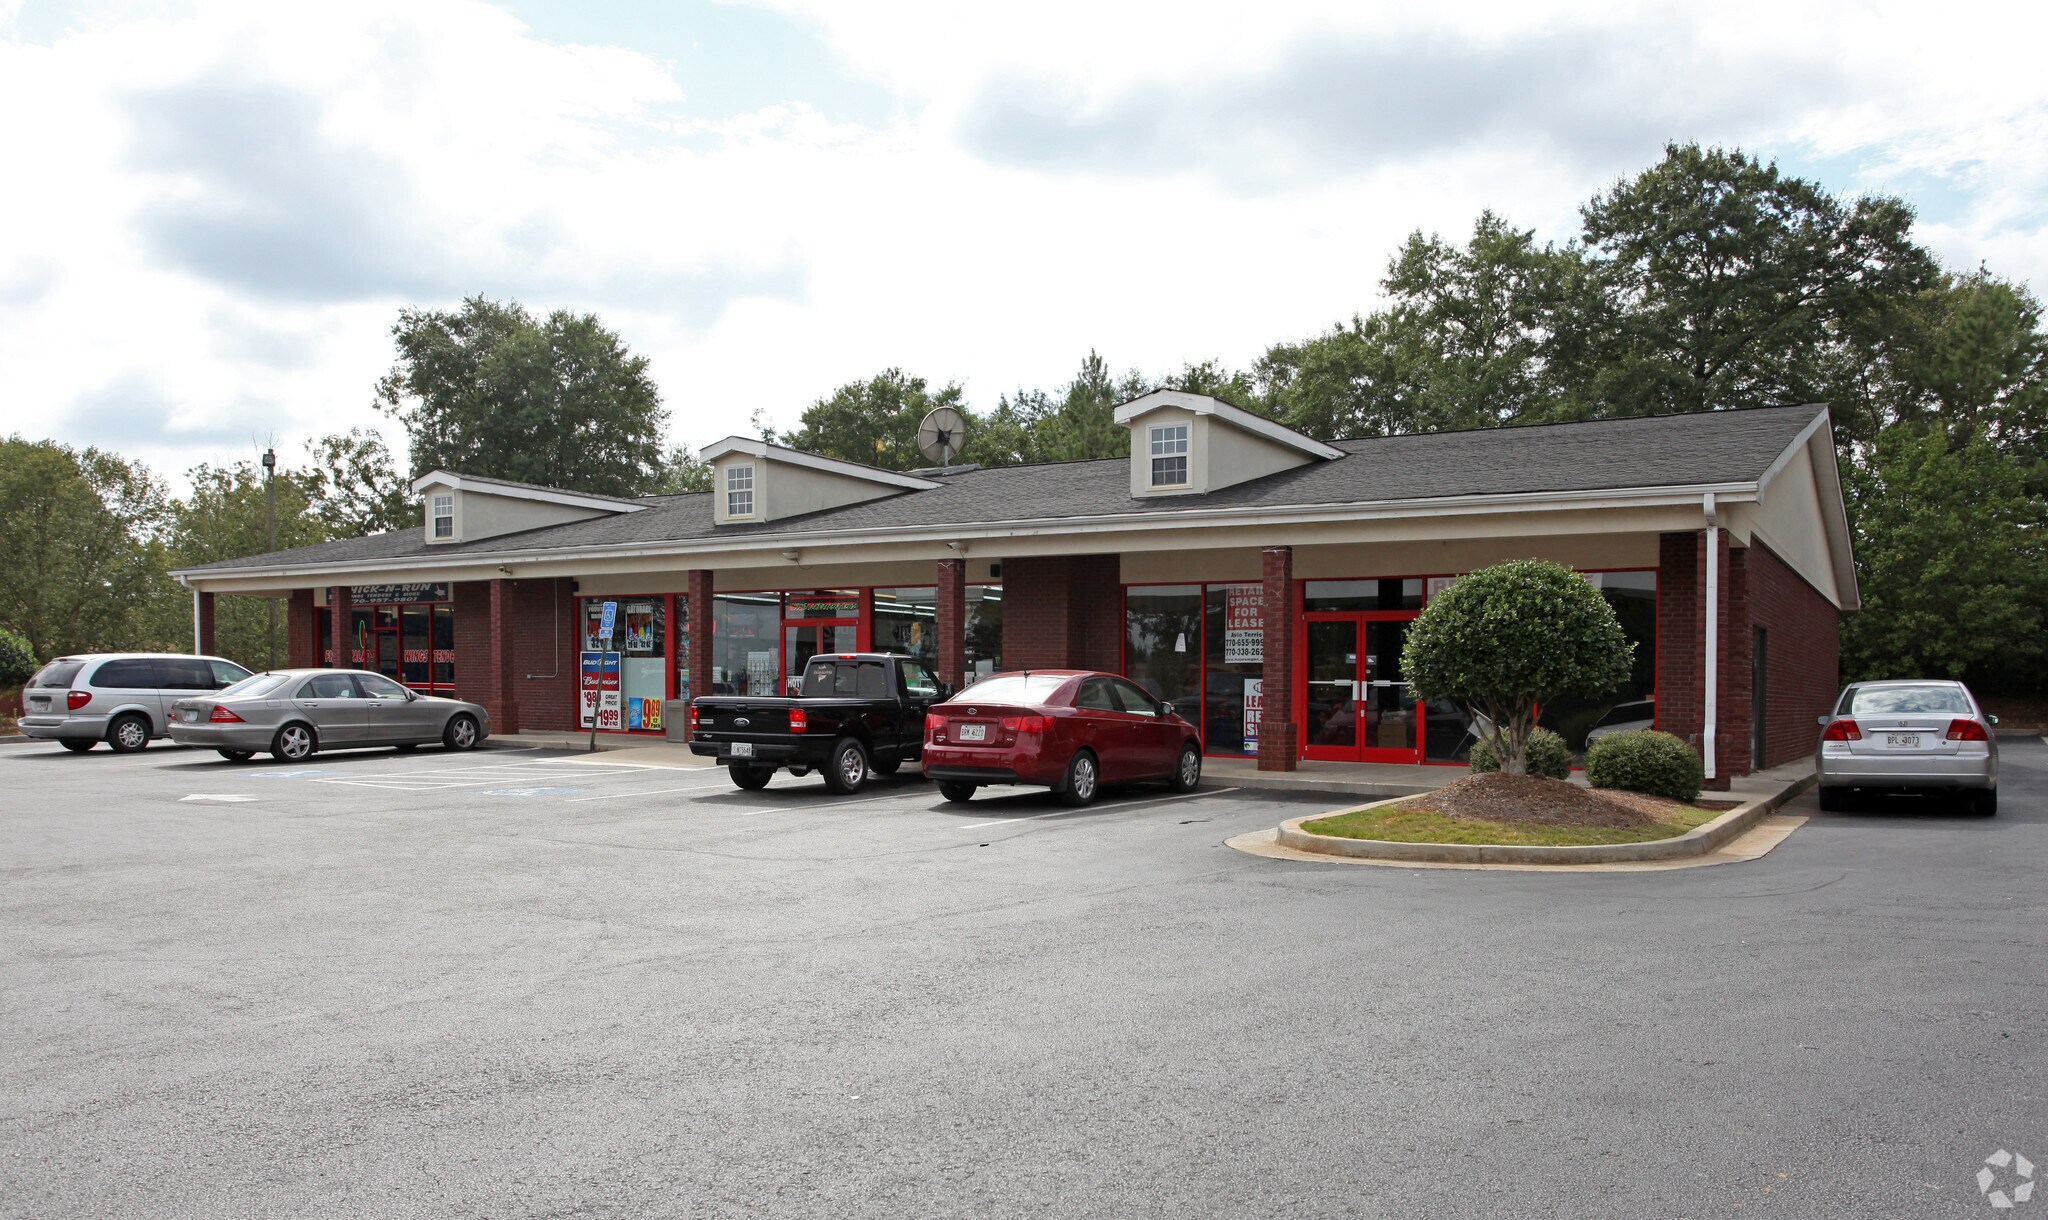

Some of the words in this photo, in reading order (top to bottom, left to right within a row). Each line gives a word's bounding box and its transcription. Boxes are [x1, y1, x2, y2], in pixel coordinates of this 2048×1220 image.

[1229, 597, 1263, 606] SPACE
[1234, 607, 1258, 617] FOR
[1228, 619, 1264, 628] LEASE
[404, 649, 429, 663] WINGS
[433, 649, 455, 663] TENDE
[1246, 696, 1263, 707] LEA
[1888, 736, 1899, 744] BPL
[1904, 736, 1920, 744] 3073
